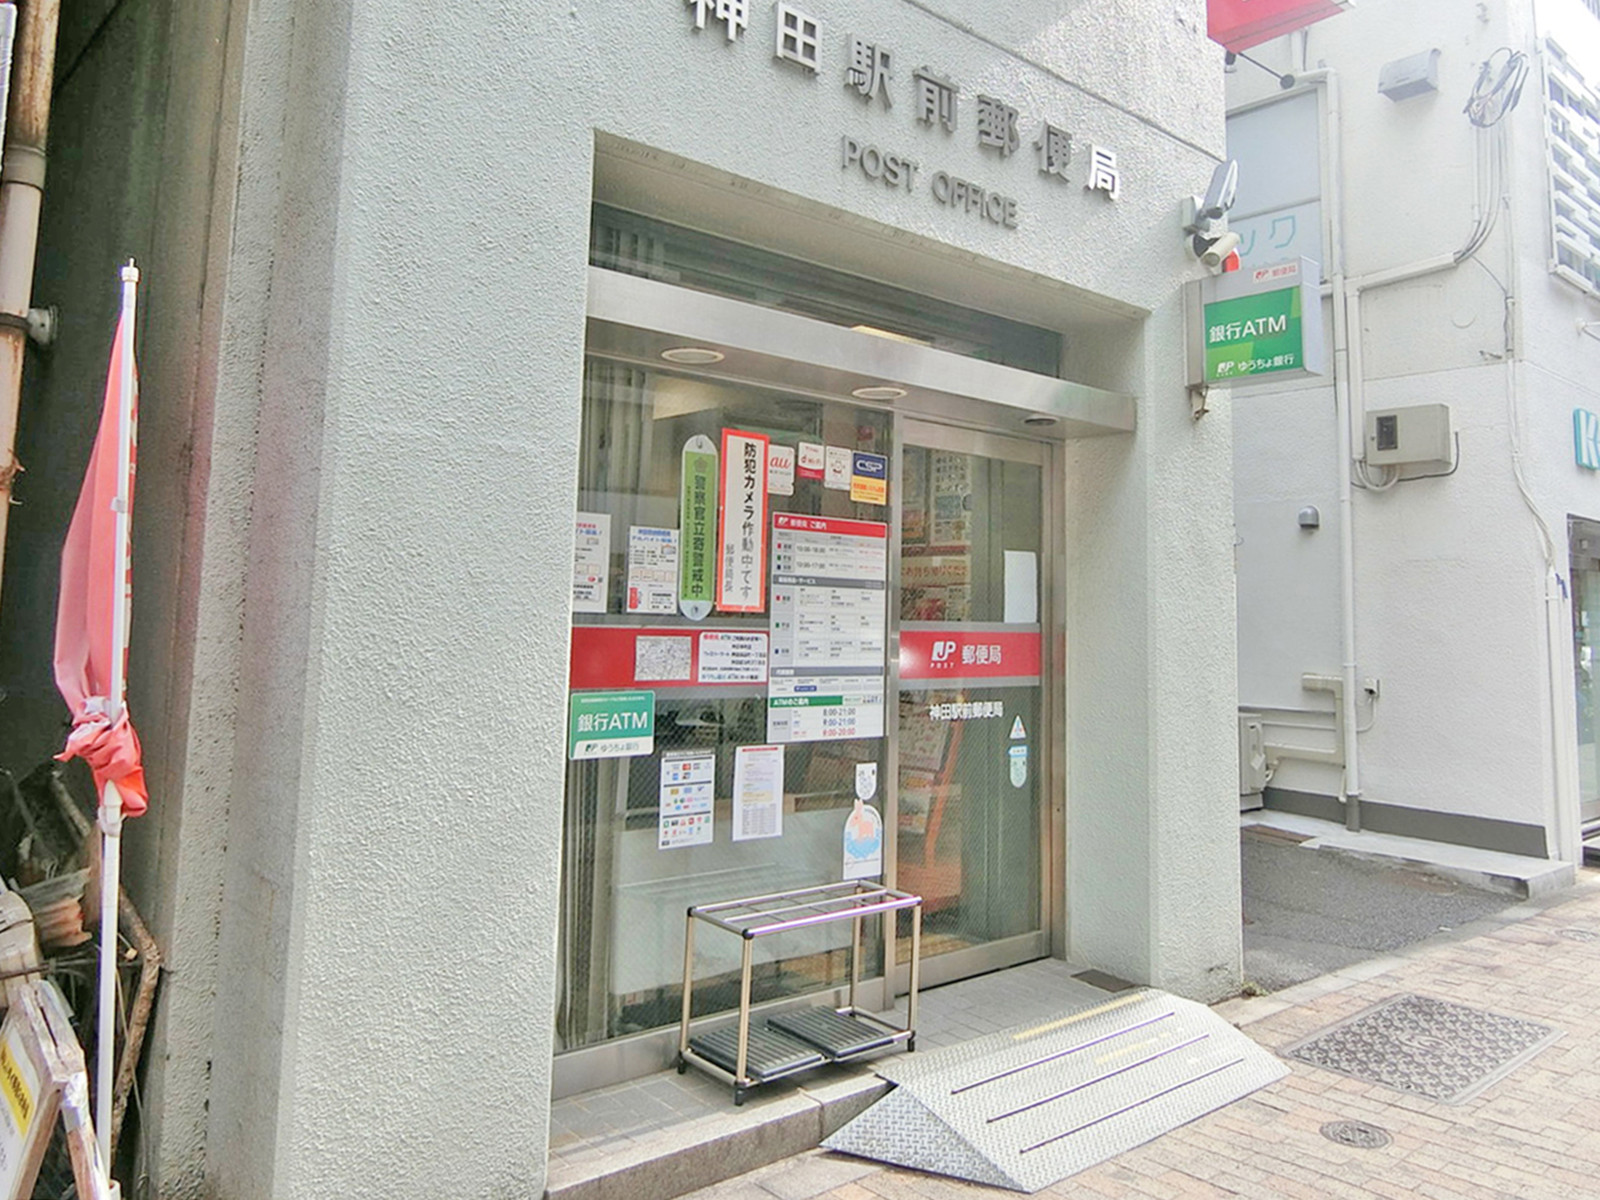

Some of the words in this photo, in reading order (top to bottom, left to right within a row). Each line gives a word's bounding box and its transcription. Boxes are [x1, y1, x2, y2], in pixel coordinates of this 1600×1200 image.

[841, 135, 917, 192] POST
[931, 170, 1018, 229] OFFICE
[1209, 315, 1286, 343] 銀行ATM
[1238, 353, 1295, 371] ゆうちょ銀行
[770, 456, 791, 469] au
[961, 645, 1002, 665] 郵便局
[929, 701, 1004, 721] 神田駅前郵便局
[577, 711, 648, 733] 銀行ATM
